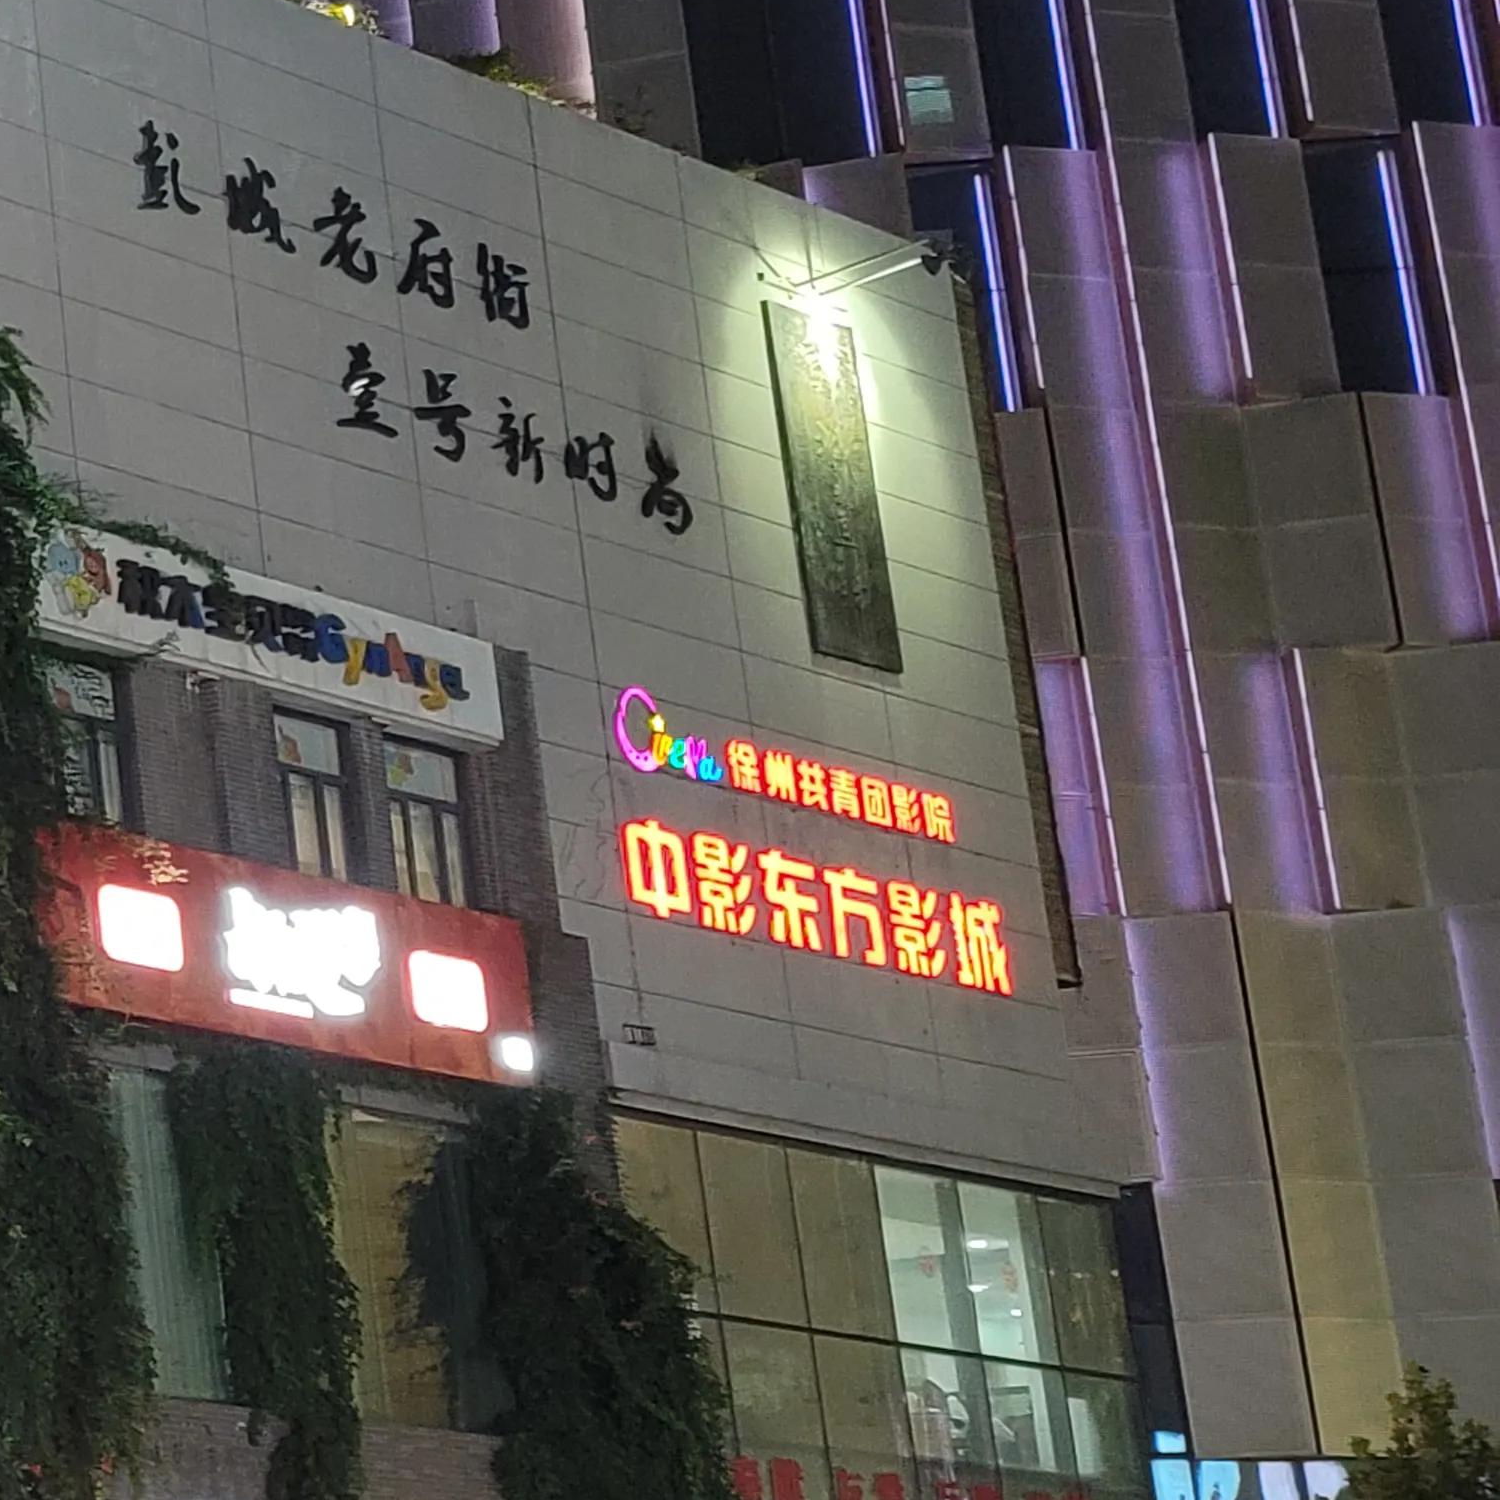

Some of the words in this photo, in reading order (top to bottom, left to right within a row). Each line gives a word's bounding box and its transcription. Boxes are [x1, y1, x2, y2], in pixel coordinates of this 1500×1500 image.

[726, 739, 956, 845] 徐州共青团影院
[620, 820, 1013, 997] 中影东方影城
